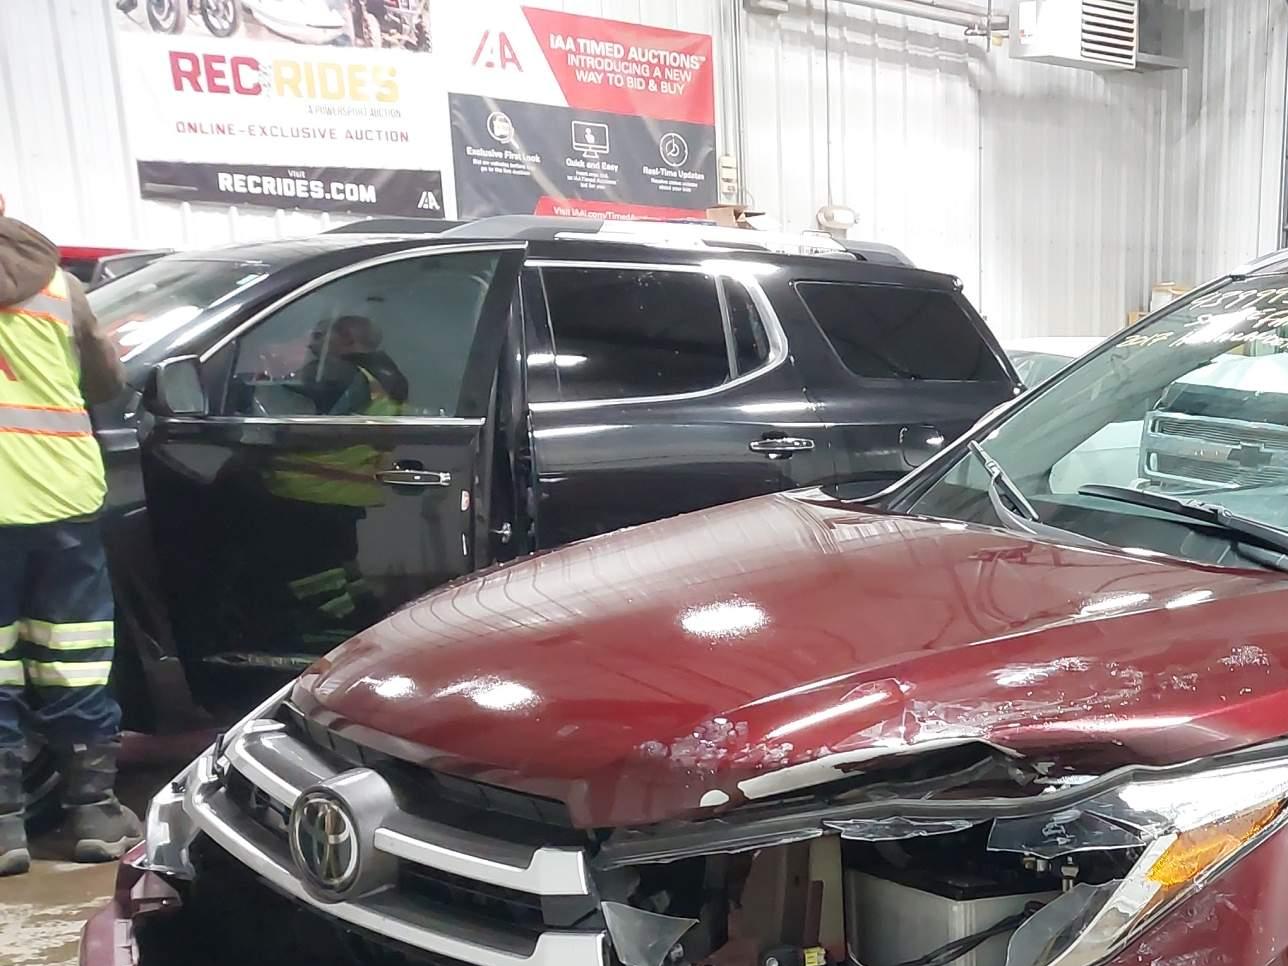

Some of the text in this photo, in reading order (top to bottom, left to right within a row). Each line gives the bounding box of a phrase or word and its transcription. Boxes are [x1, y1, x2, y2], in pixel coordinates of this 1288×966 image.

[550, 34, 576, 52] IAA
[578, 39, 624, 59] TIMED
[169, 50, 401, 104] REC RIDES
[568, 54, 692, 82] INTRODUCING A NEW
[575, 70, 685, 96] WAY TO BID & BUY
[176, 121, 410, 143] ONLINE-EXCLUSIVE AUCTION
[466, 146, 503, 159] Exclusive
[288, 169, 306, 178] Visit
[566, 157, 618, 173] Quick and Easy
[642, 166, 705, 181] Real-Time Updates
[218, 173, 377, 204] RECRIDES.COM
[553, 206, 571, 217] Visit
